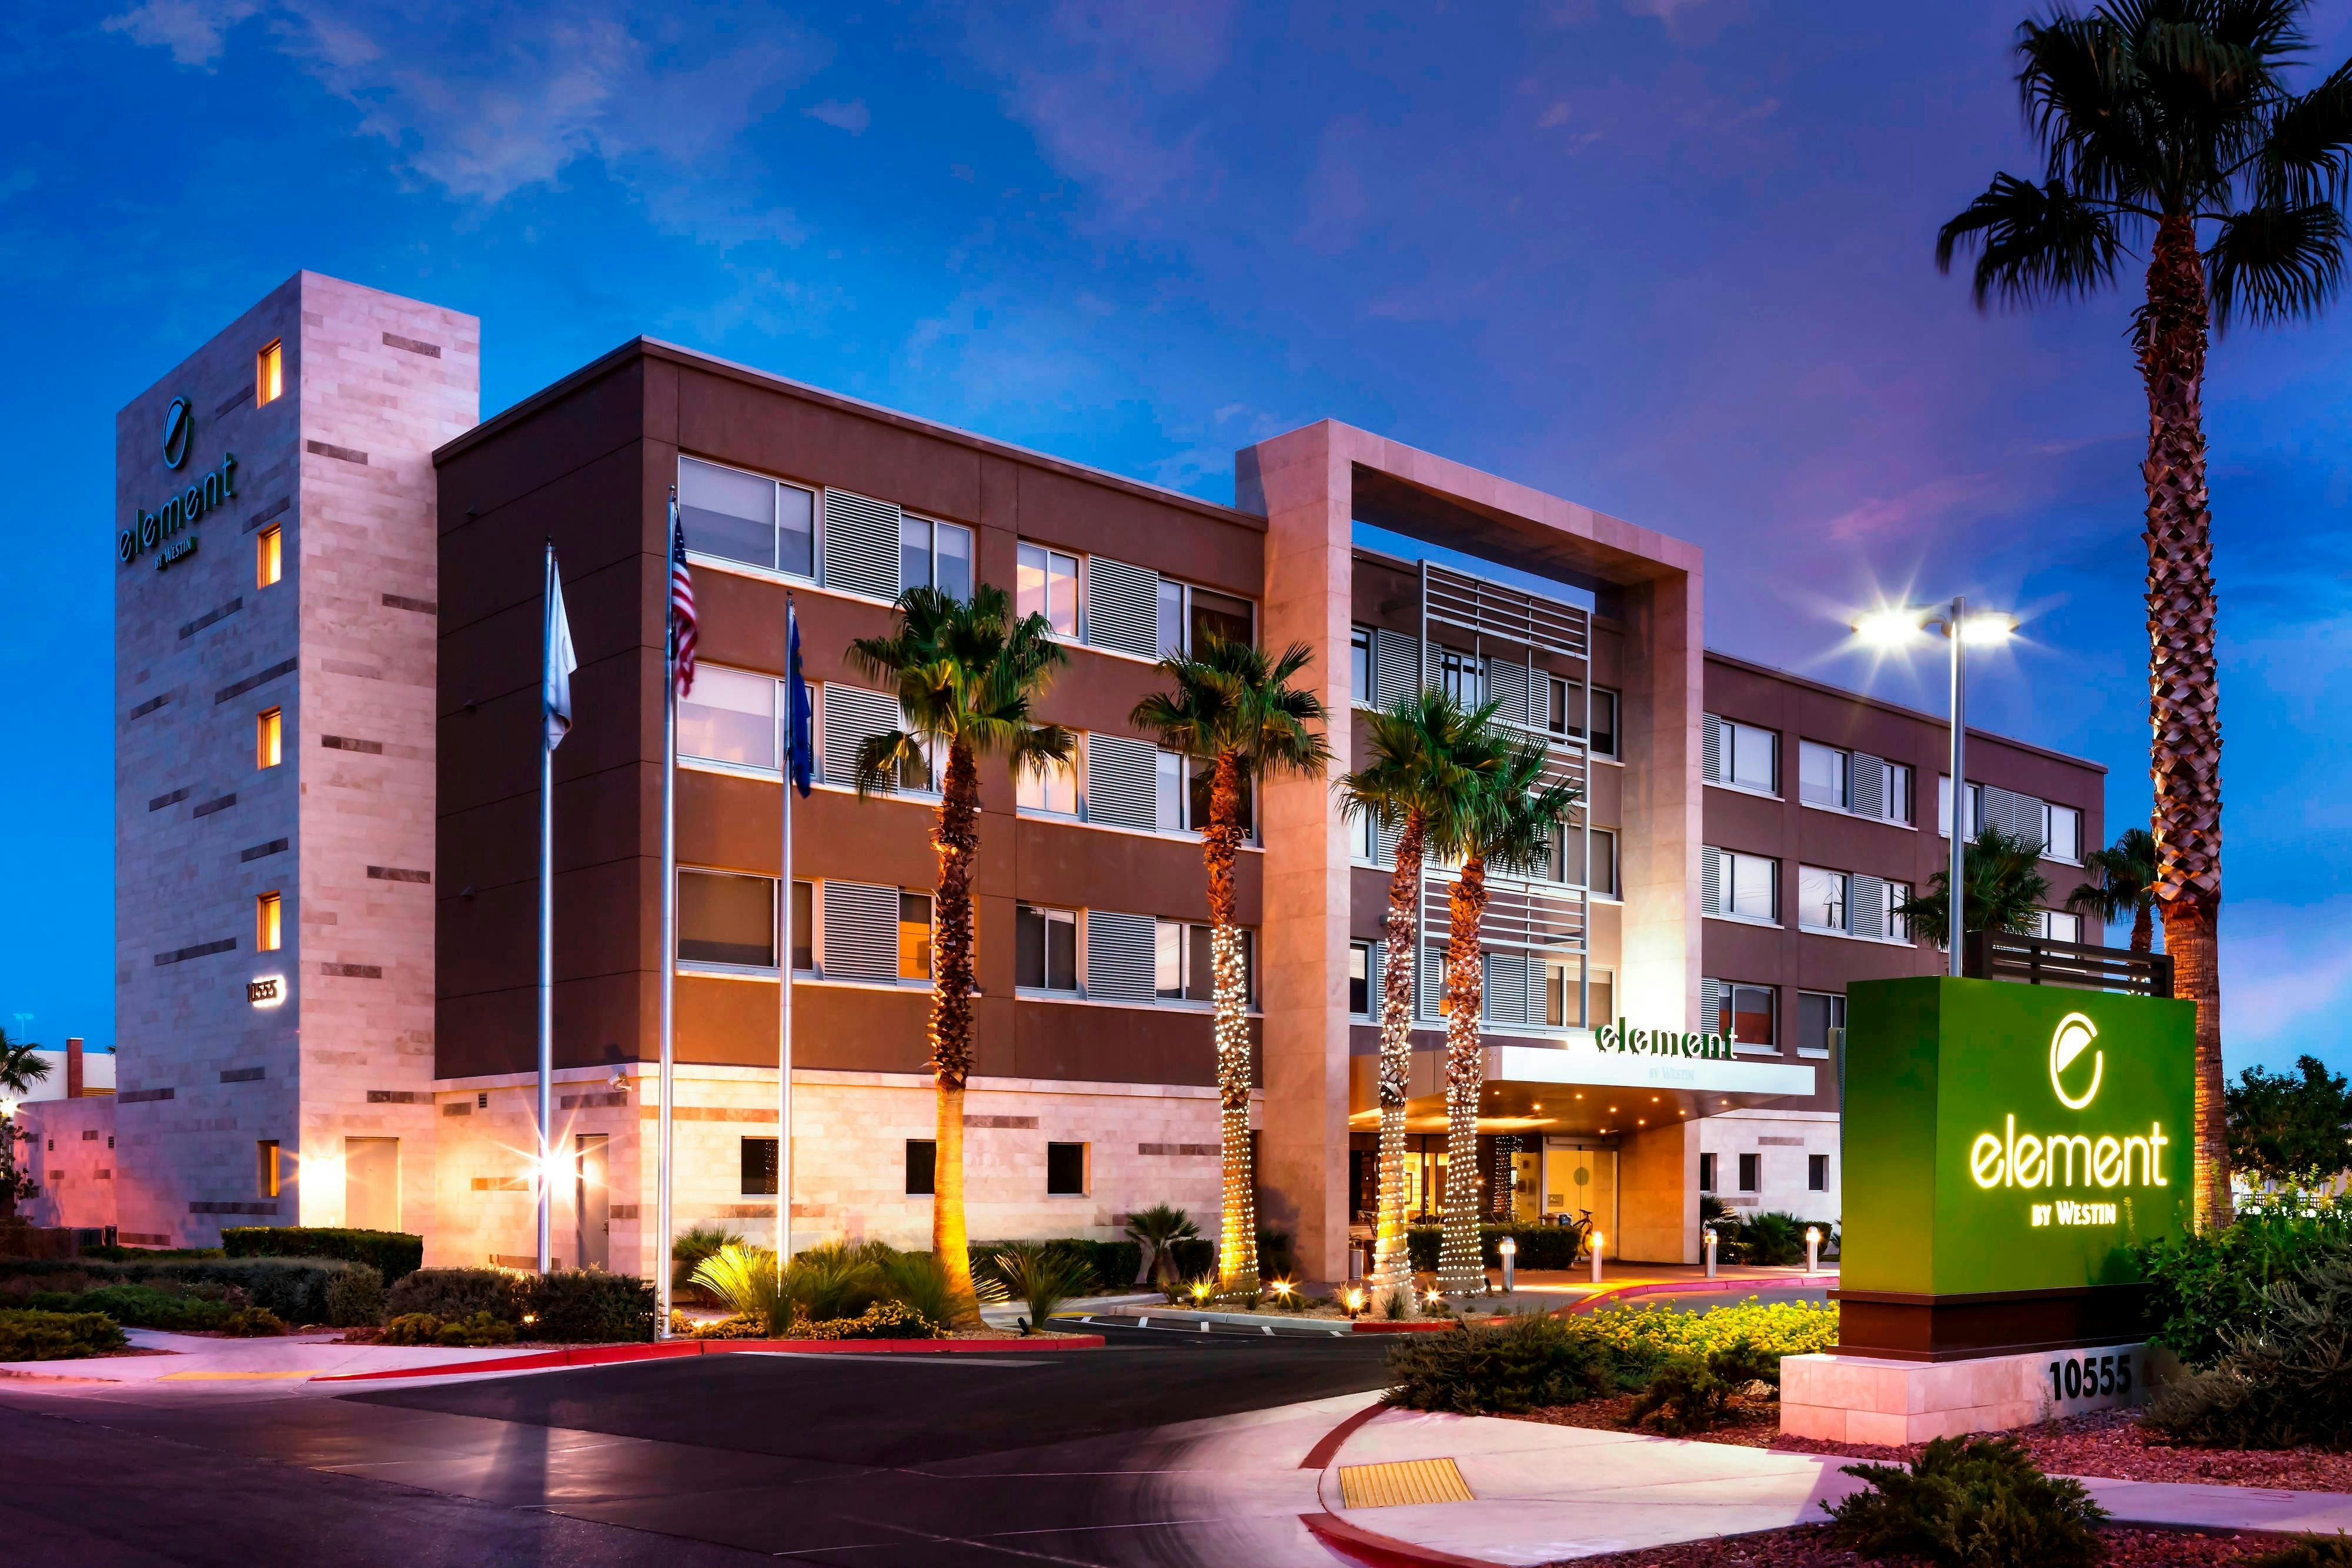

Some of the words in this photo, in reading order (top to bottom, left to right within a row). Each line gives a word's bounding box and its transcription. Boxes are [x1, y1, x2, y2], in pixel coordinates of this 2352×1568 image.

[119, 452, 238, 563] element
[154, 554, 167, 570] BY
[1595, 1017, 1738, 1059] element
[1971, 1114, 2169, 1188] element
[2032, 1205, 2052, 1226] BY
[2049, 1354, 2132, 1400] 10555
